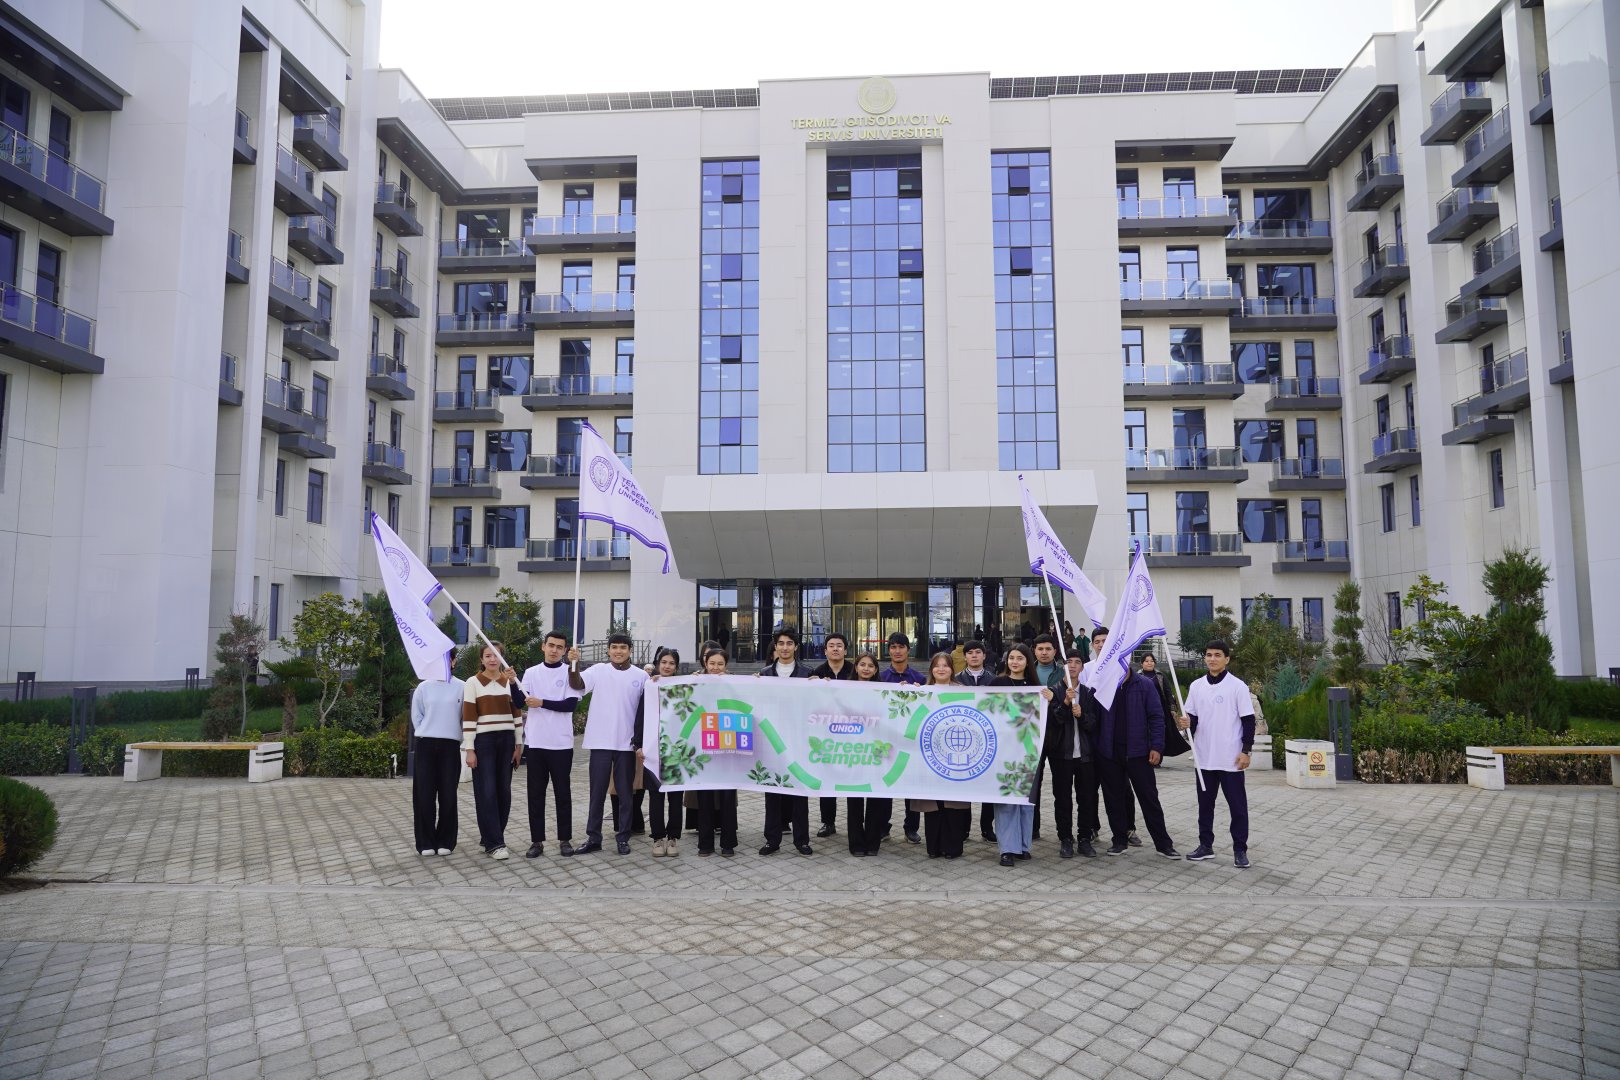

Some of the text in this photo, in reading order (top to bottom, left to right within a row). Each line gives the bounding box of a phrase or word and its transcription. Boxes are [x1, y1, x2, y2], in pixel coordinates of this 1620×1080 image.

[791, 113, 953, 129] TERMIZ IQTISODIYOT VA
[808, 127, 943, 142] SERVIS UNIVERSITETI
[706, 715, 748, 730] EDU
[808, 713, 880, 728] STUDENT
[963, 709, 989, 728] SERVIS
[831, 724, 862, 733] UNION
[923, 709, 950, 752] IQTISODIYOT
[706, 733, 749, 748] HUB
[821, 738, 880, 753] Green
[808, 750, 883, 768] Campus
[968, 728, 995, 777] UNIVERSITETI
[927, 753, 951, 777] TERMIZ
